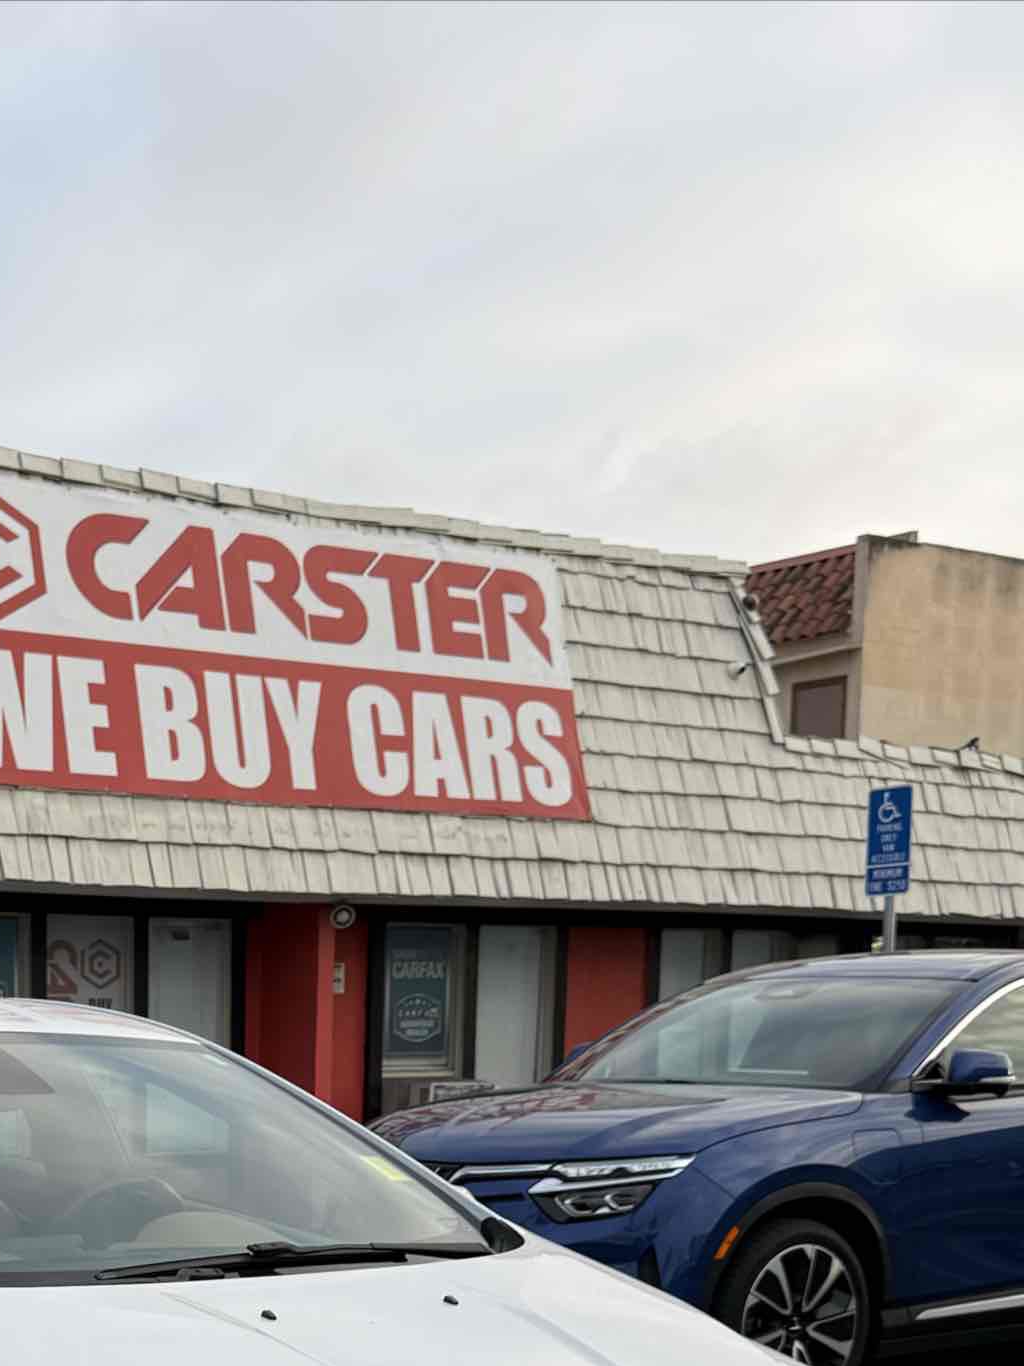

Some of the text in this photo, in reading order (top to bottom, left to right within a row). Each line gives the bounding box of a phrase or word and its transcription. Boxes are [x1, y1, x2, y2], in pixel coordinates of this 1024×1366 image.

[65, 511, 555, 669] CARSTER
[134, 662, 322, 792] BUY
[345, 682, 574, 808] CARS
[392, 960, 445, 979] CARFAX
